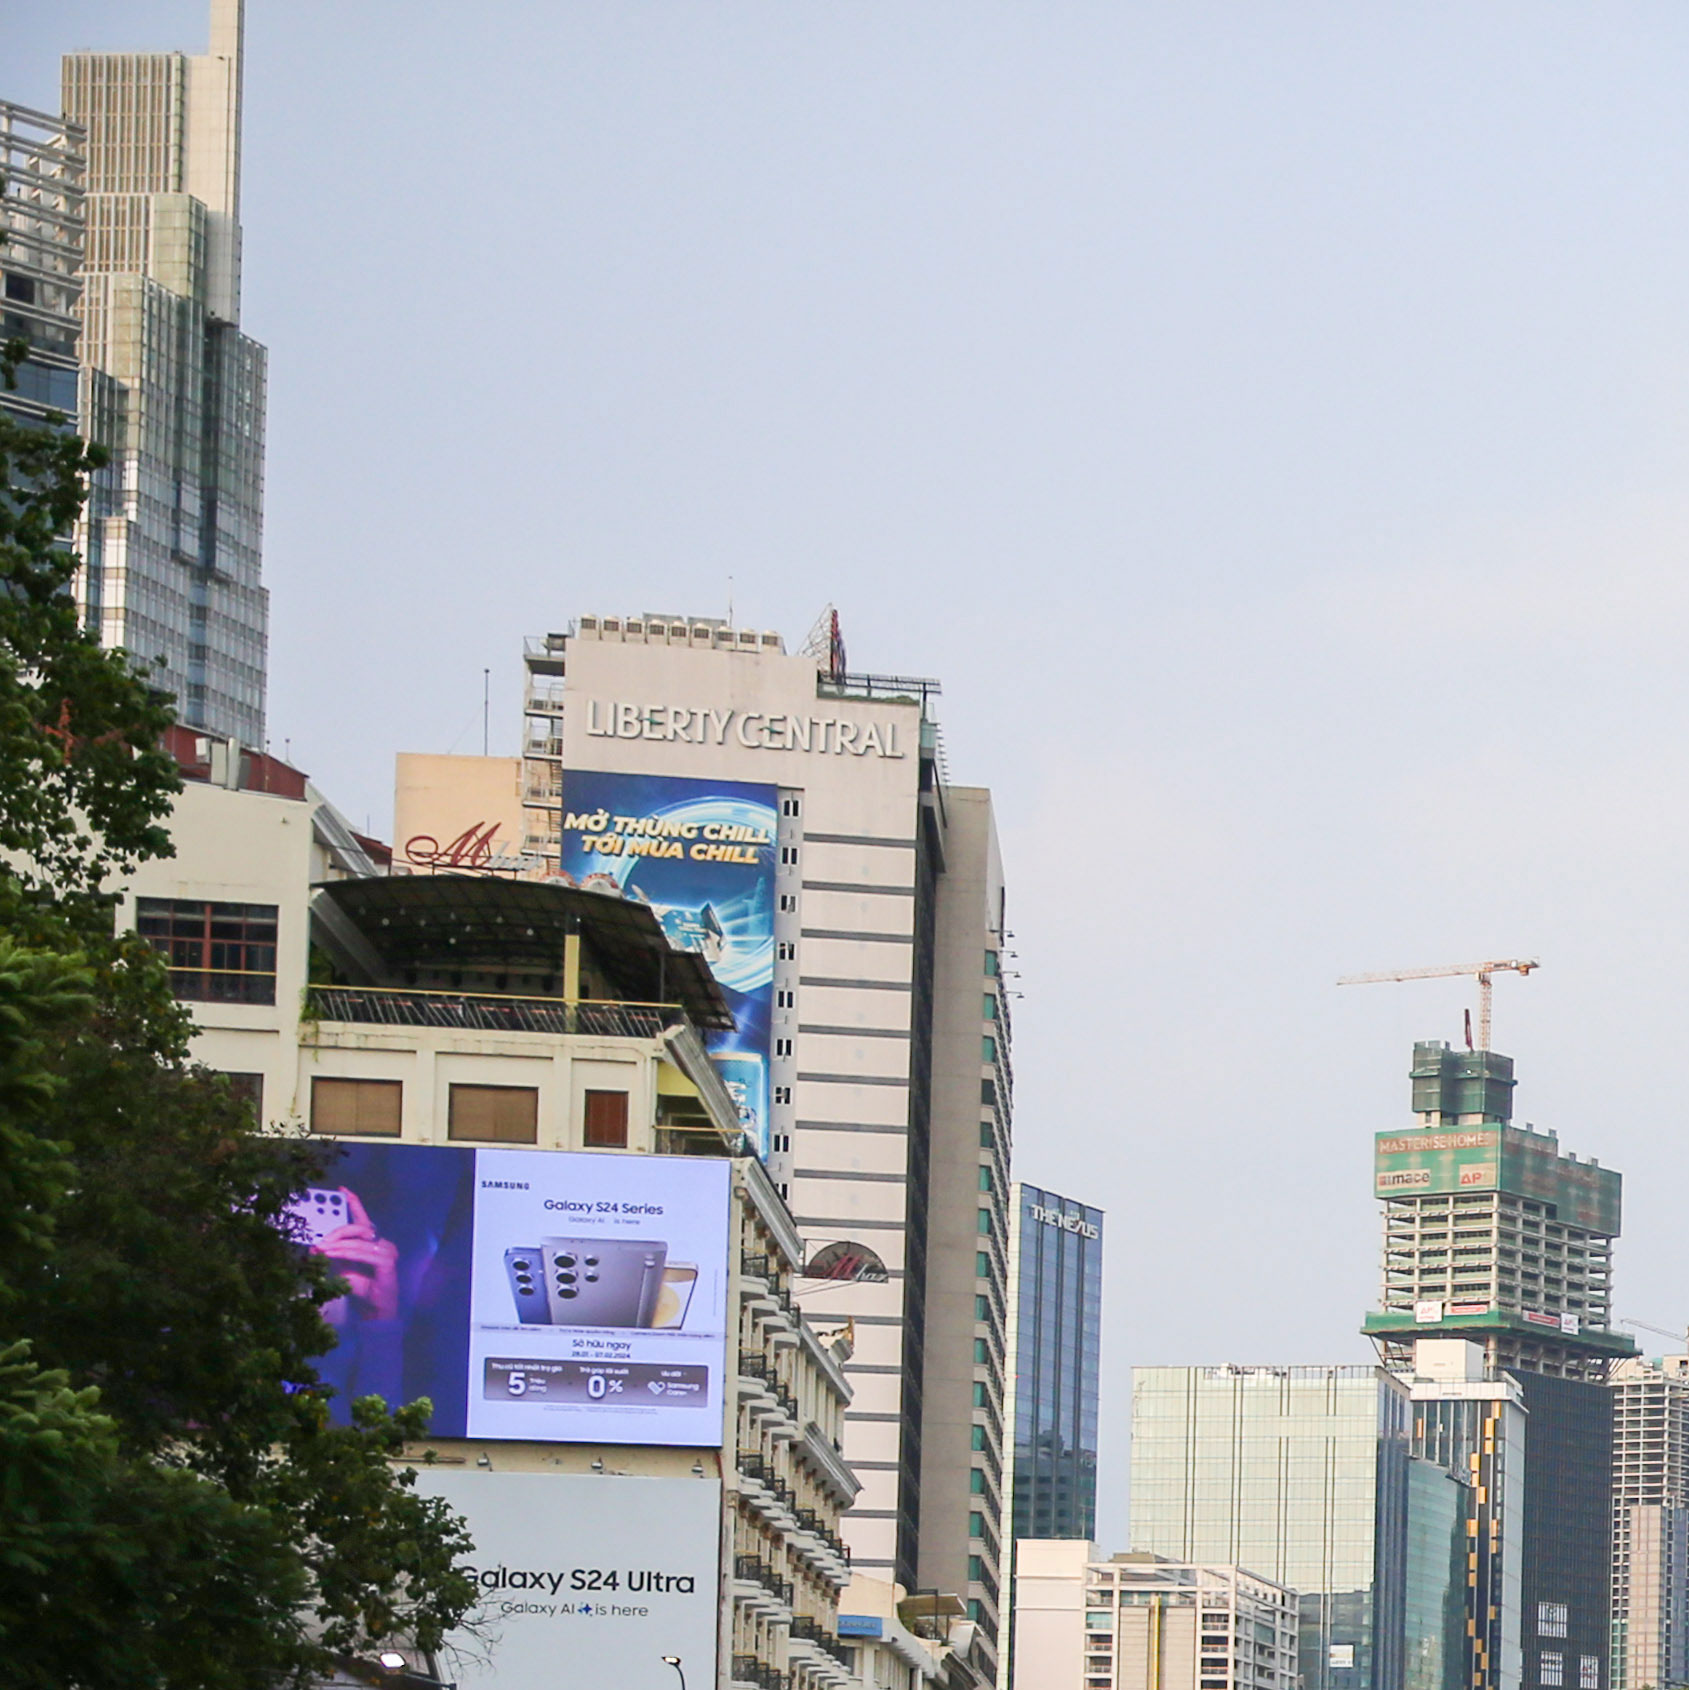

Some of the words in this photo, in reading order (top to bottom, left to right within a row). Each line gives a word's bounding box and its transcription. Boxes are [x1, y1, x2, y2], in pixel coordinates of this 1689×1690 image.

[586, 701, 733, 744] LIBERTY
[737, 712, 904, 759] CENTRAL
[564, 807, 608, 831] MỞ
[614, 814, 698, 839] THÙNG
[703, 823, 771, 844] CHILL
[582, 834, 637, 857] TỚI
[642, 838, 684, 860] MÙA
[690, 842, 760, 865] CHILL
[481, 1179, 530, 1191] SAMSUNG
[1392, 1171, 1430, 1185] mace
[543, 1199, 594, 1215] Galaxy
[596, 1201, 619, 1214] S24
[622, 1203, 664, 1216] Series
[508, 1371, 526, 1396] 5
[587, 1374, 606, 1400] 0
[608, 1379, 624, 1394] %
[461, 1564, 565, 1595] Galaxy
[570, 1569, 621, 1592] S24
[628, 1569, 695, 1594] Ultra
[501, 1600, 557, 1618] Galaxy
[561, 1602, 575, 1616] AI
[595, 1603, 607, 1617] is
[611, 1603, 649, 1618] here
